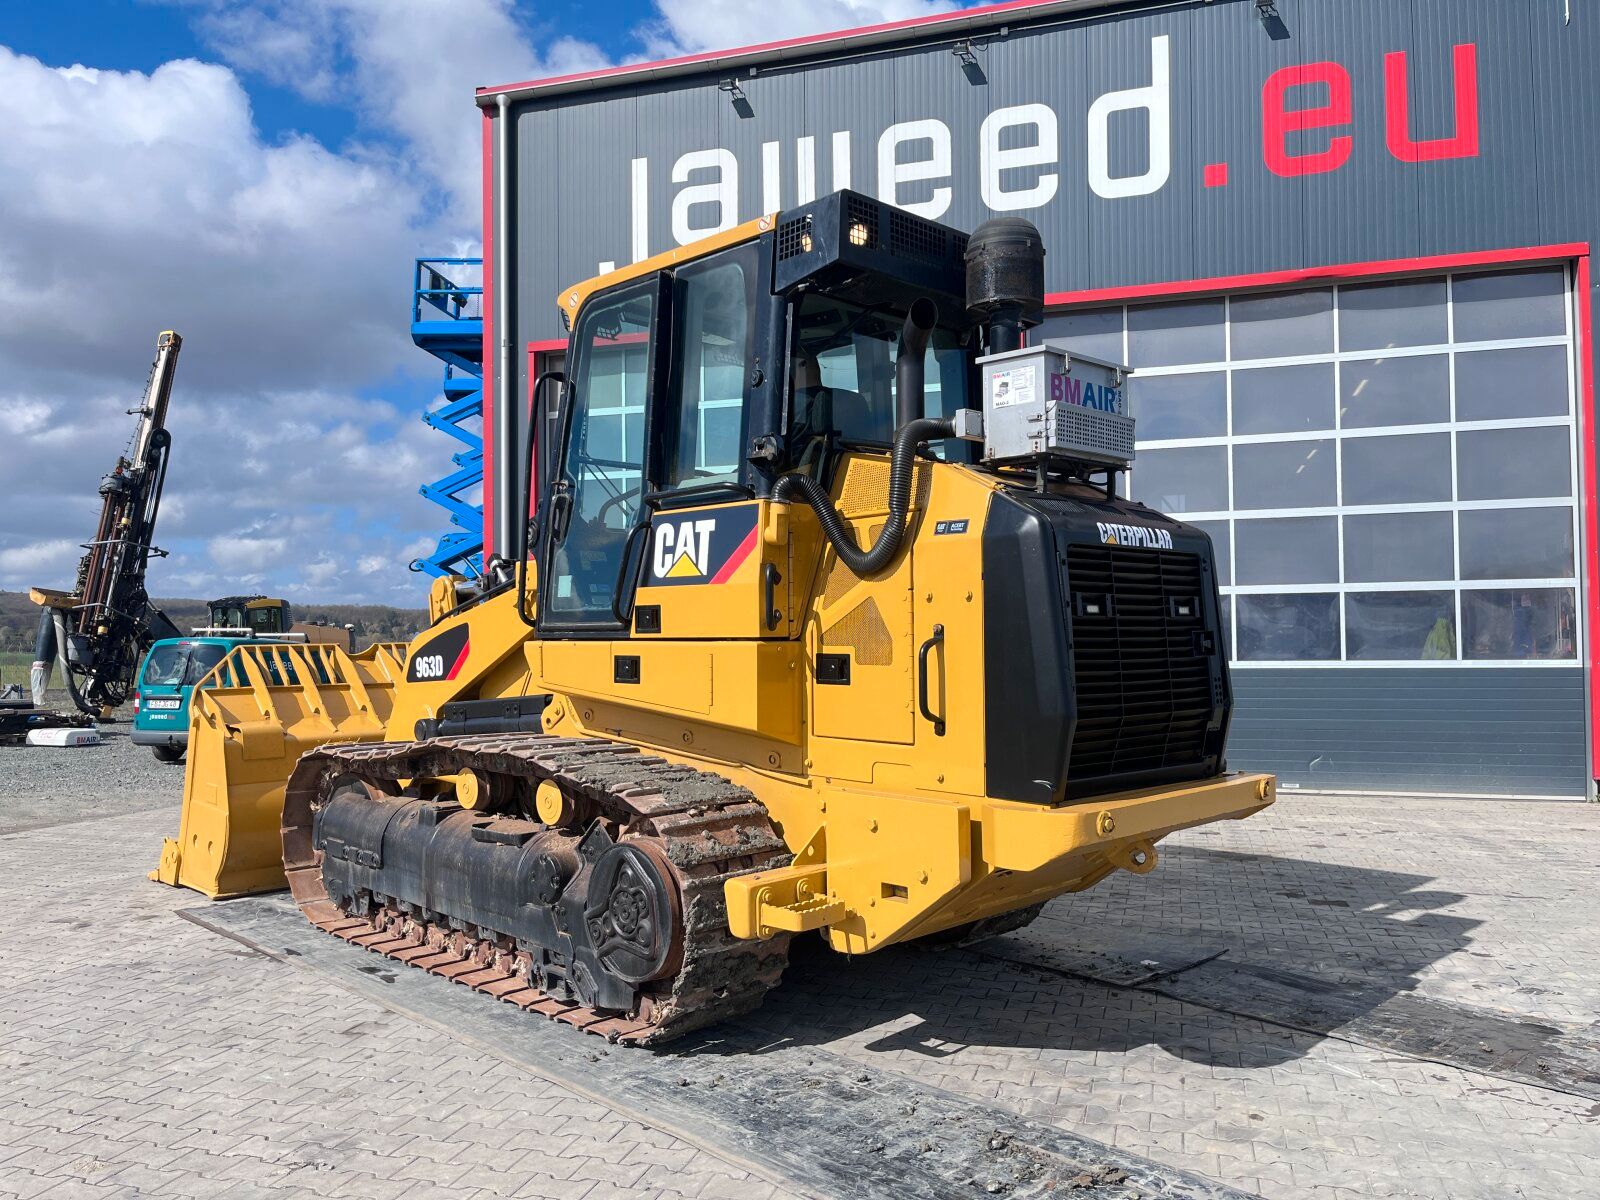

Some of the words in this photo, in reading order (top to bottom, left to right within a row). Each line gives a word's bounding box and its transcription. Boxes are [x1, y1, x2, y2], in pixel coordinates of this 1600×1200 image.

[1051, 372, 1117, 414] BMAIR
[654, 518, 716, 579] CAT
[1097, 521, 1173, 550] CATERPILLAR
[415, 655, 443, 678] 963D
